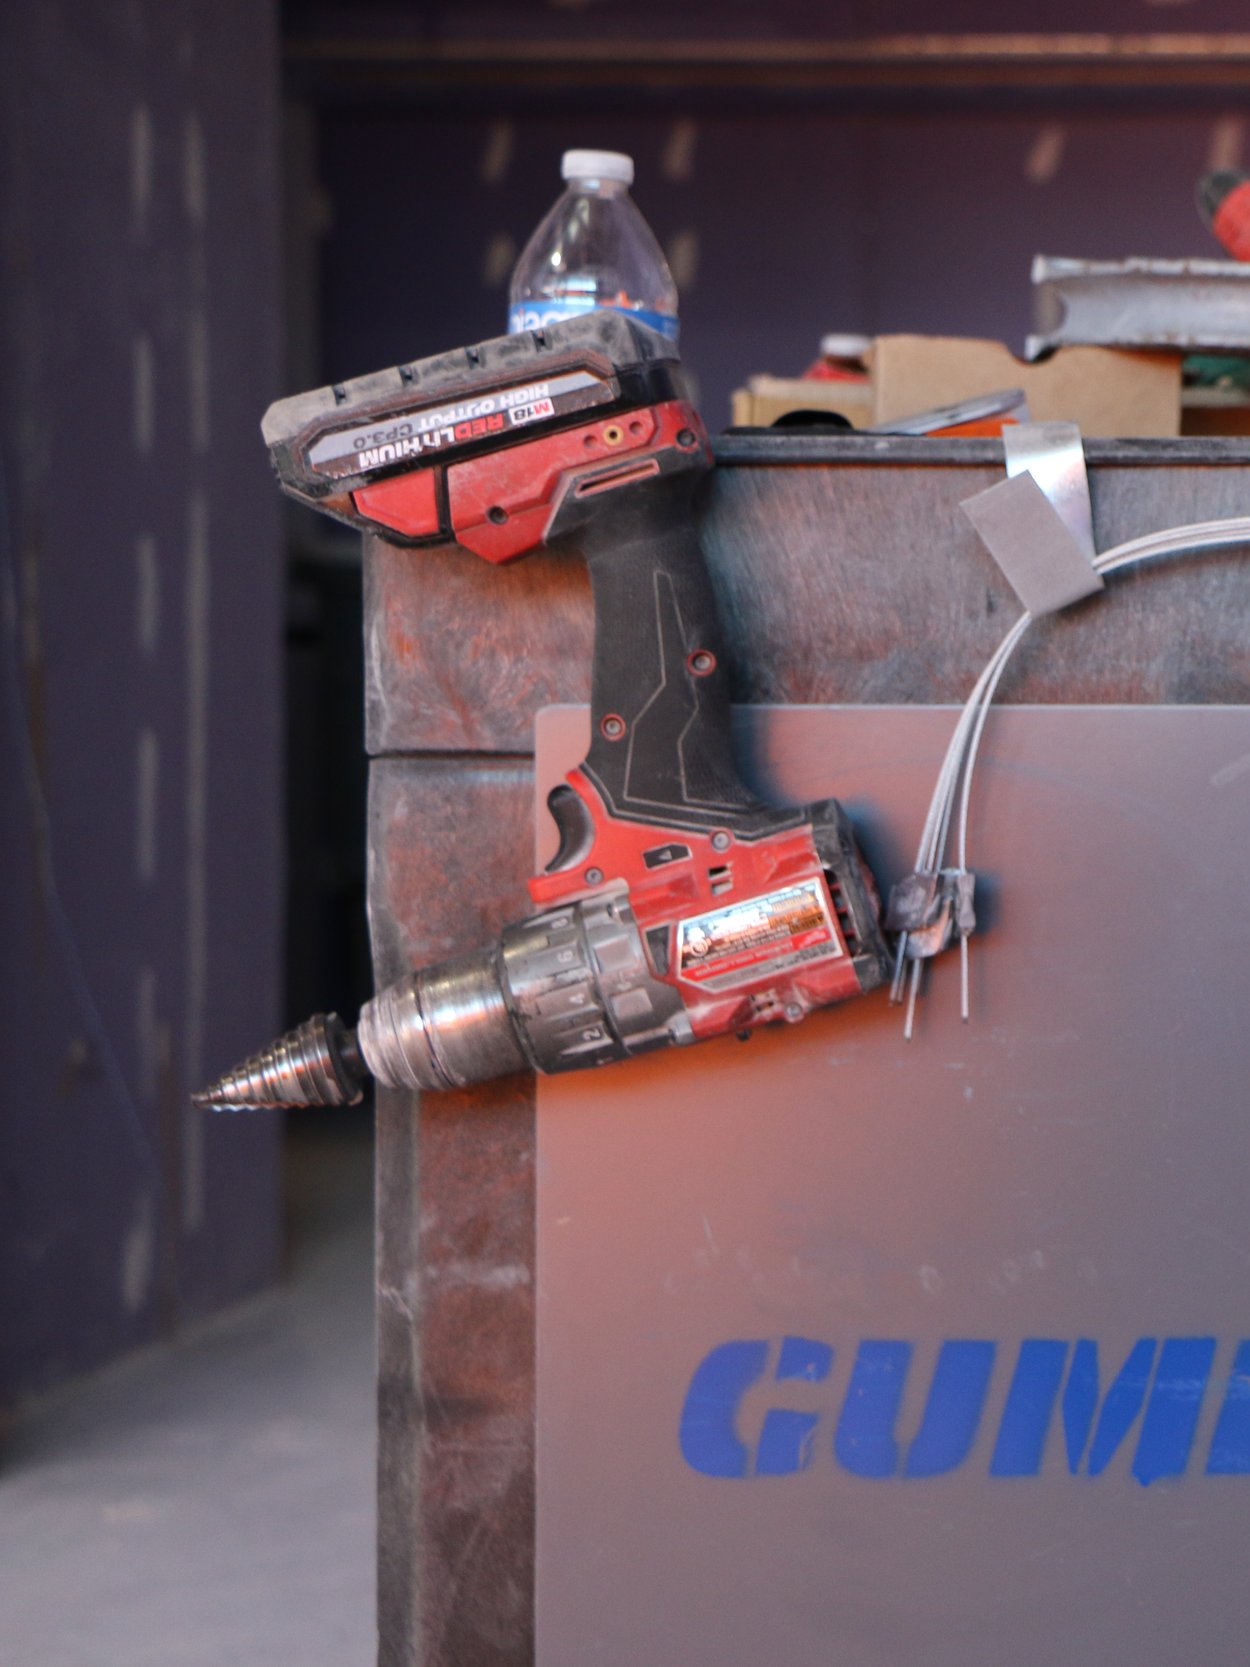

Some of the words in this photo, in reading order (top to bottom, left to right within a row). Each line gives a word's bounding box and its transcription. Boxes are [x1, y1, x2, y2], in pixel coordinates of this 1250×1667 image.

[500, 384, 549, 408] HIGH
[418, 400, 496, 433] OUTPUT
[513, 401, 551, 421] M18
[353, 423, 413, 449] CP3.0
[569, 992, 585, 1004] 4
[583, 1028, 601, 1041] 2
